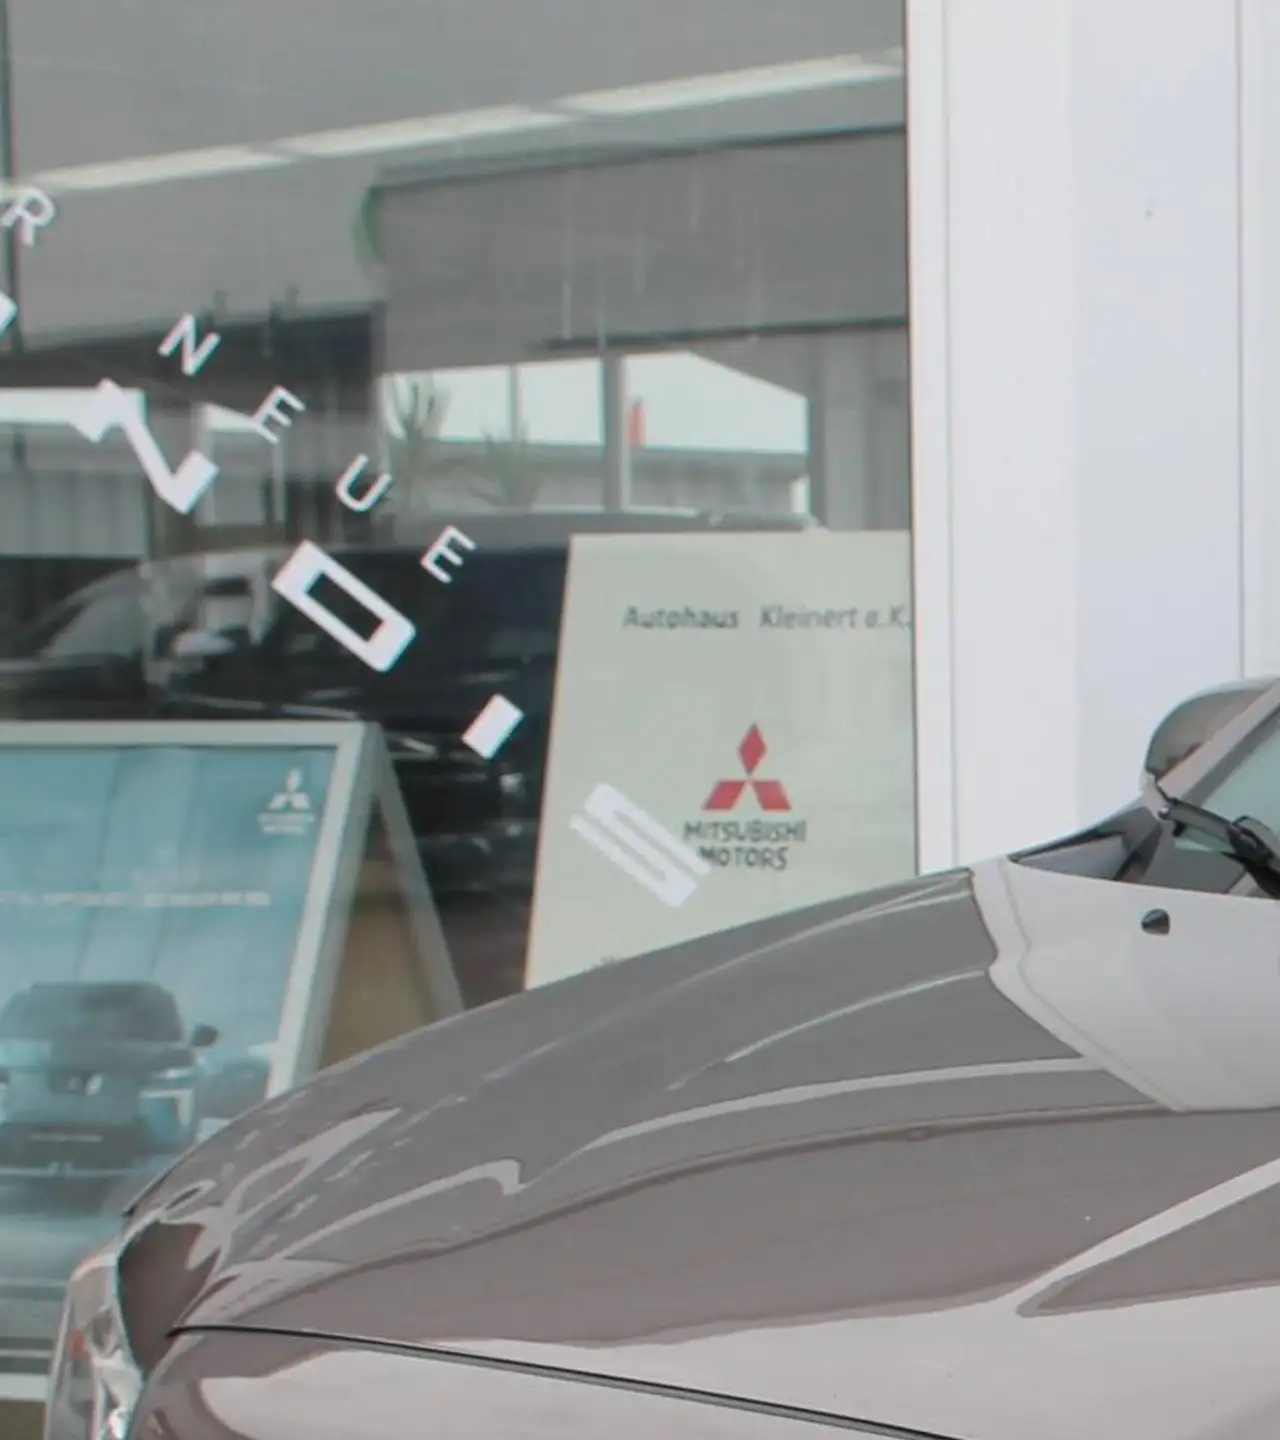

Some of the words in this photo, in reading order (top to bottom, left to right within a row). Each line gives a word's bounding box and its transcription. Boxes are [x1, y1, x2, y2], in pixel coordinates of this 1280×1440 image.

[158, 313, 477, 584] NEUE
[0, 292, 712, 908] NDIS
[622, 605, 740, 630] Autohaus
[758, 604, 858, 630] Kleinert
[683, 820, 808, 842] MITSUBISHI
[698, 847, 788, 871] MOTORS
